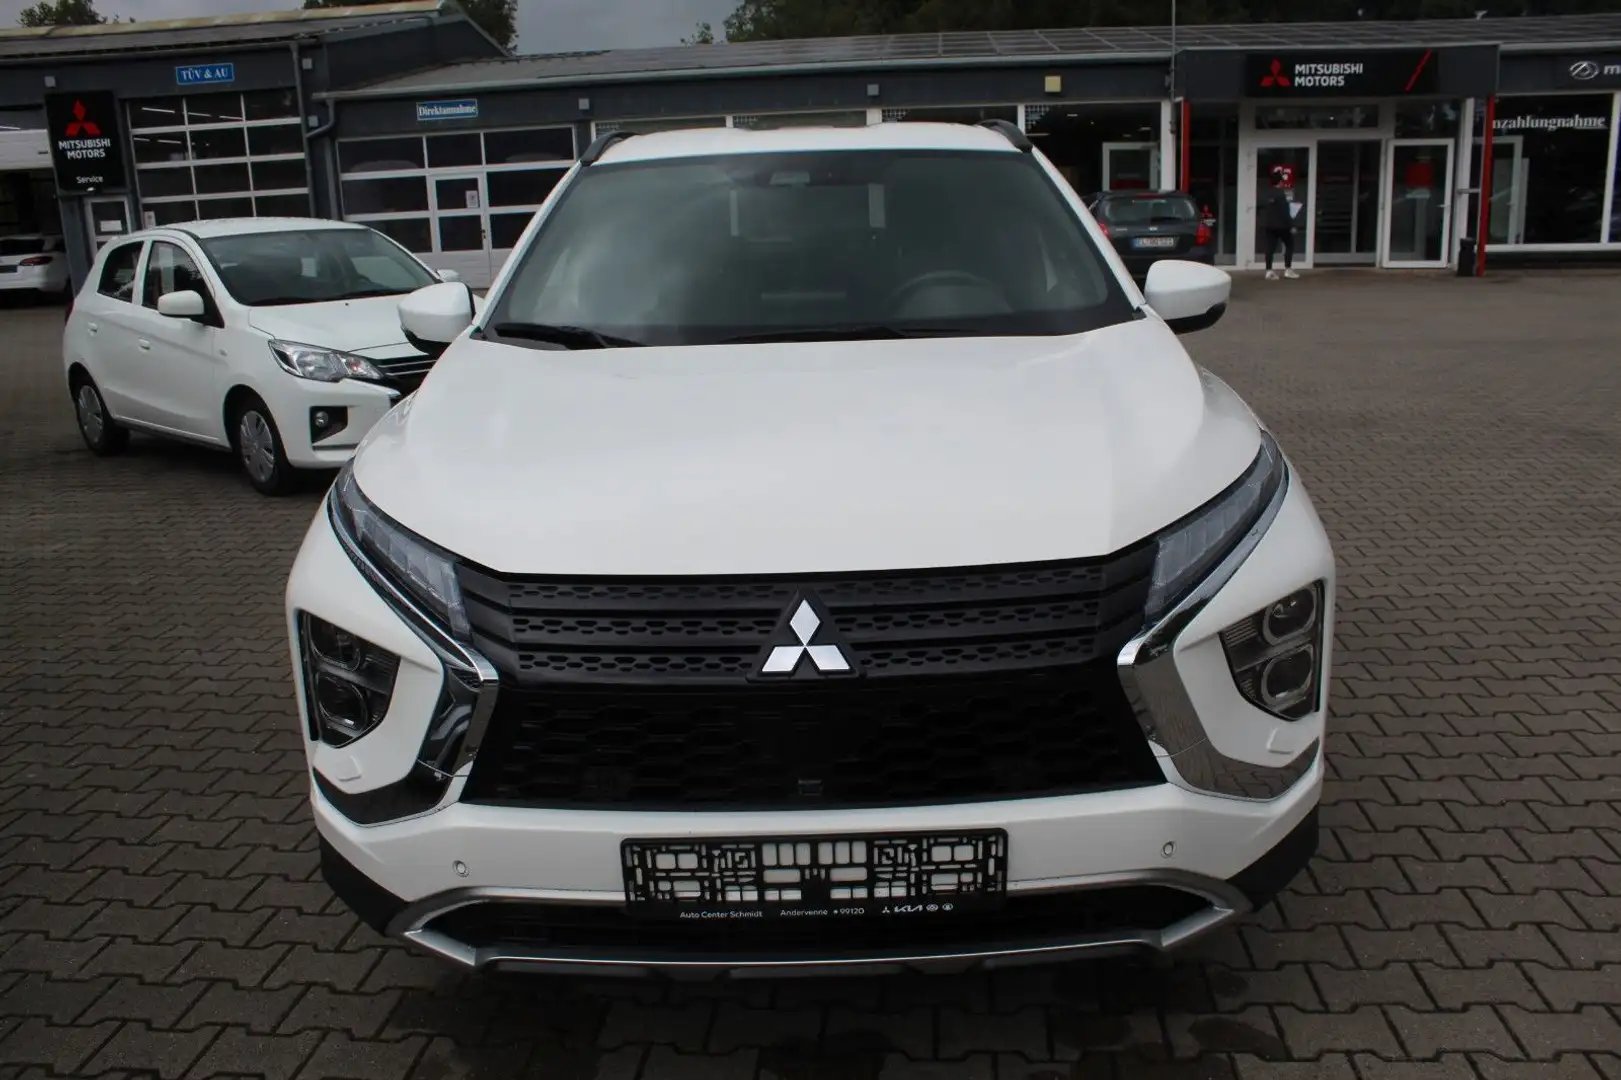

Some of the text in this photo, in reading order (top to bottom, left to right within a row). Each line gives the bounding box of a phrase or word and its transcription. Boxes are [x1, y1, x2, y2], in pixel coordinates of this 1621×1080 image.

[181, 67, 229, 80] TÜV & AU
[1294, 63, 1364, 75] MITSUBISHI
[1294, 75, 1345, 87] MOTORS
[418, 104, 477, 116] Direktannahme
[1491, 113, 1606, 132] nzahlungnahme
[58, 138, 111, 150] MITSUBISHI
[66, 148, 106, 160] MOTORS
[76, 175, 104, 184] Service
[679, 910, 700, 919] Auto
[701, 910, 728, 919] Center
[730, 910, 764, 919] Schmidt
[780, 907, 828, 917] Andervenne
[839, 907, 865, 916] 99120
